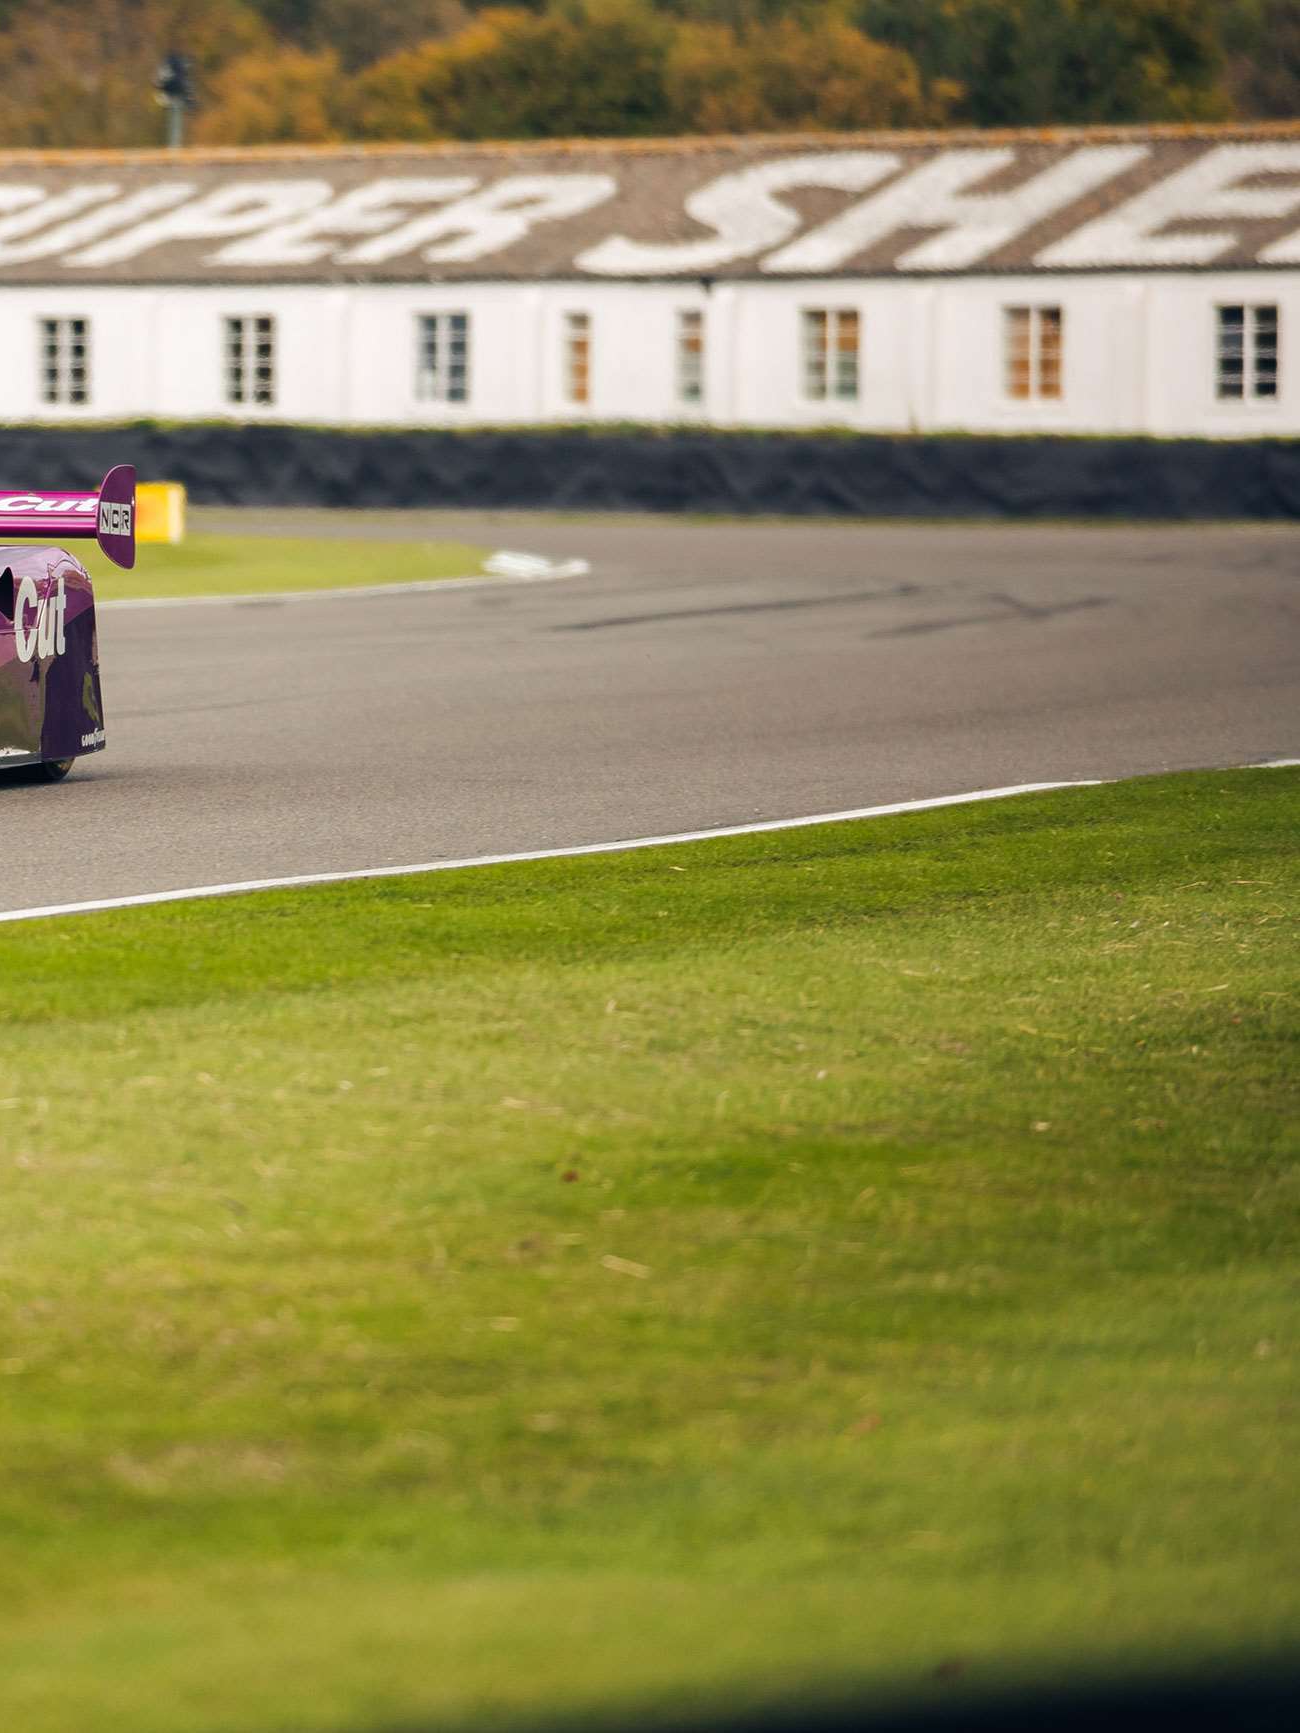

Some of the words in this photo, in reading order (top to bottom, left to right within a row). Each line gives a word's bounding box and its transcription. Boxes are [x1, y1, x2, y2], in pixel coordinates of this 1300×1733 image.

[574, 142, 1300, 276] SHE
[101, 508, 130, 530] NCR
[14, 576, 67, 663] Cut
